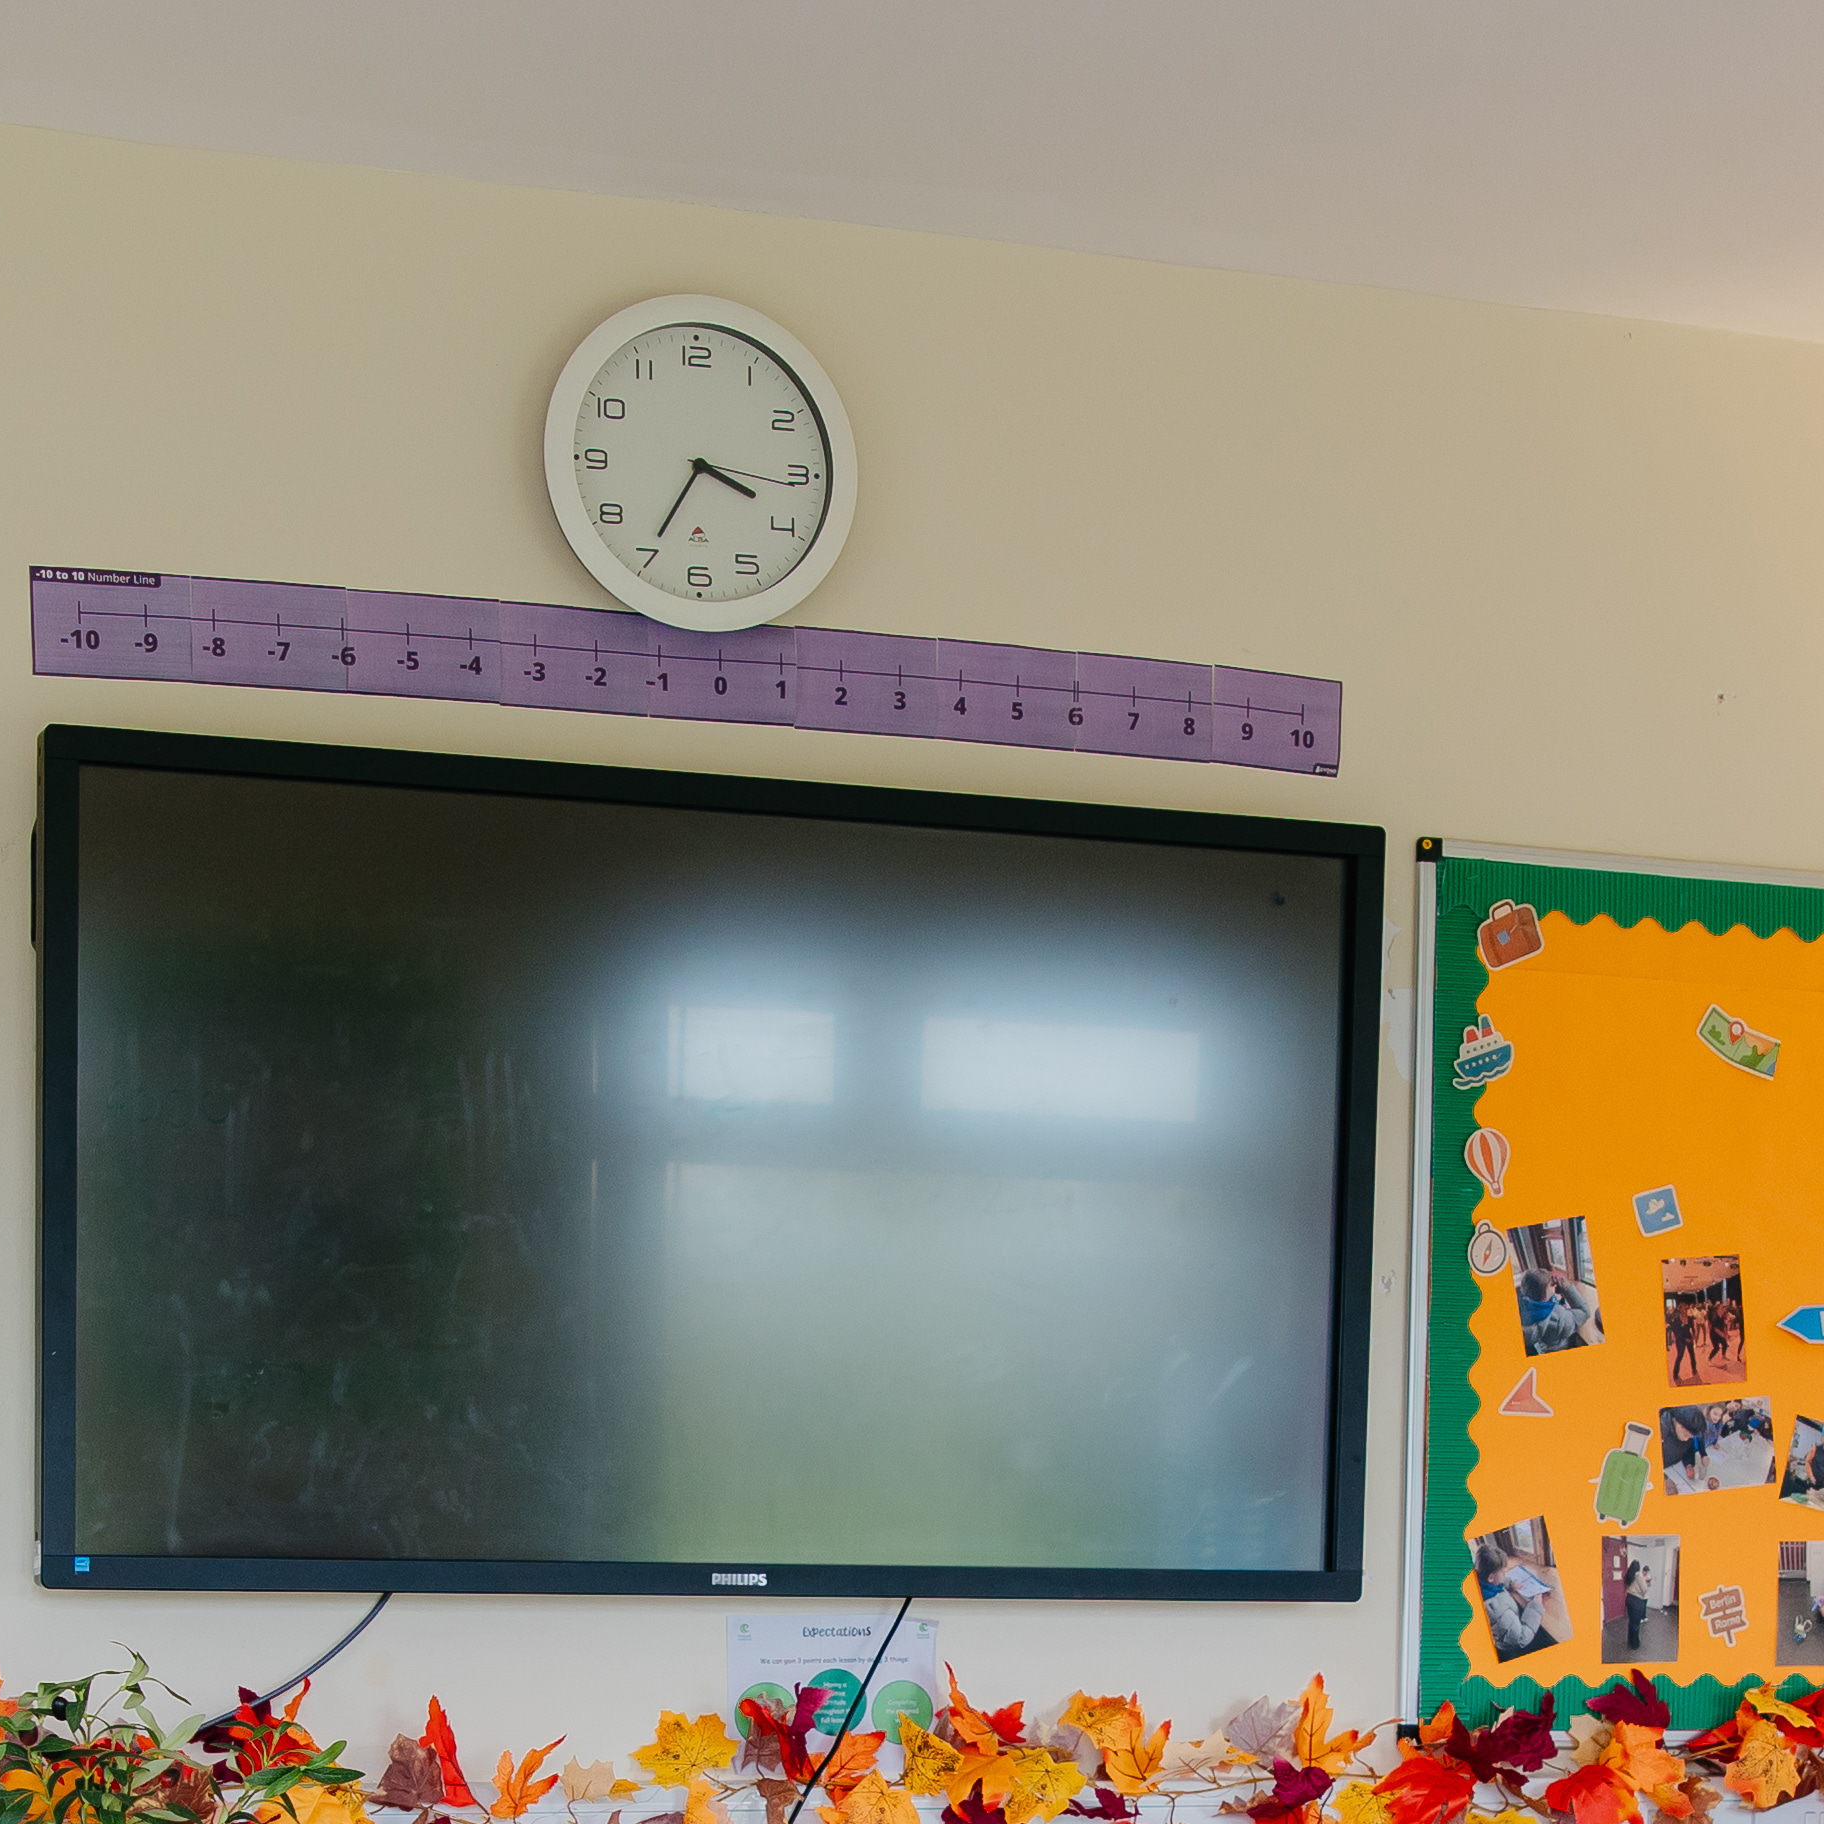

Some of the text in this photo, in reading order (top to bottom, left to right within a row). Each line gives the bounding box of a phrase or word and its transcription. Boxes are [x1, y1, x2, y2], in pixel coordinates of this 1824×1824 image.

[682, 345, 712, 368] 12
[636, 359, 652, 380] 11
[748, 365, 752, 386] 1
[598, 397, 625, 419] 10
[771, 409, 795, 432] 2
[584, 448, 608, 470] 9
[788, 464, 809, 486] 3
[599, 503, 623, 524] 8
[770, 515, 795, 537] 4
[635, 547, 659, 568] 7
[735, 553, 759, 575] 5
[36, 570, 155, 585] -10 to 10 Number Line
[687, 566, 712, 587] 6
[60, 629, 1314, 749] -10 -9 -8 -7 -6 -5 -4 -3 -2 -1 0 1 2 3 4 5 6 7 8 9 10
[711, 1572, 768, 1586] PHILIPS
[1710, 1595, 1736, 1609] Berlin
[802, 1626, 872, 1638] Expectations
[1715, 1616, 1740, 1629] Rome
[803, 1657, 821, 1665] points
[858, 1657, 865, 1665] by
